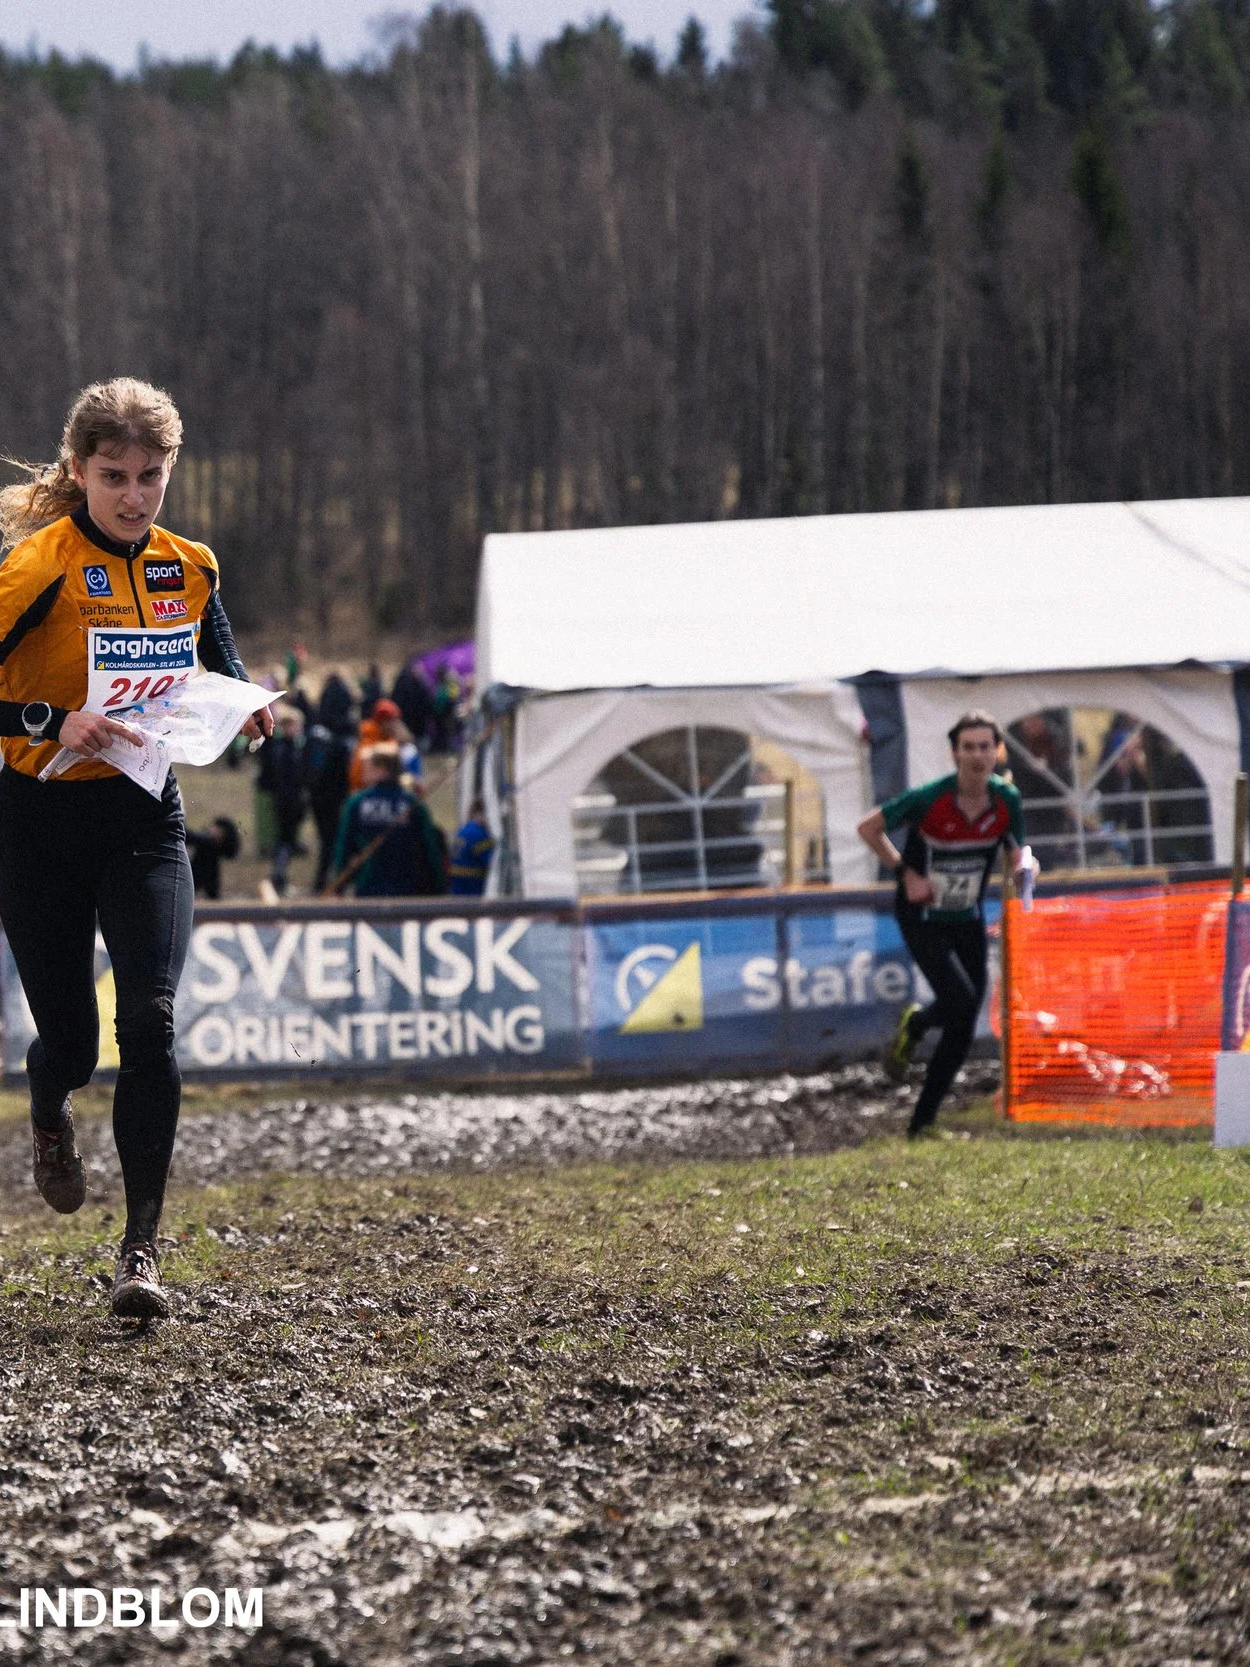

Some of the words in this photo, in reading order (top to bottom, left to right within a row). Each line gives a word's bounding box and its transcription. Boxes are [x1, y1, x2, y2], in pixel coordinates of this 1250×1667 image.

[146, 564, 183, 581] sport
[88, 617, 123, 628] Skåne
[95, 636, 192, 659] bagheera
[105, 661, 156, 669] KOLMÅRDSKAVLEN
[190, 917, 541, 1004] SVENSK
[189, 1005, 544, 1067] ORIENTERING
